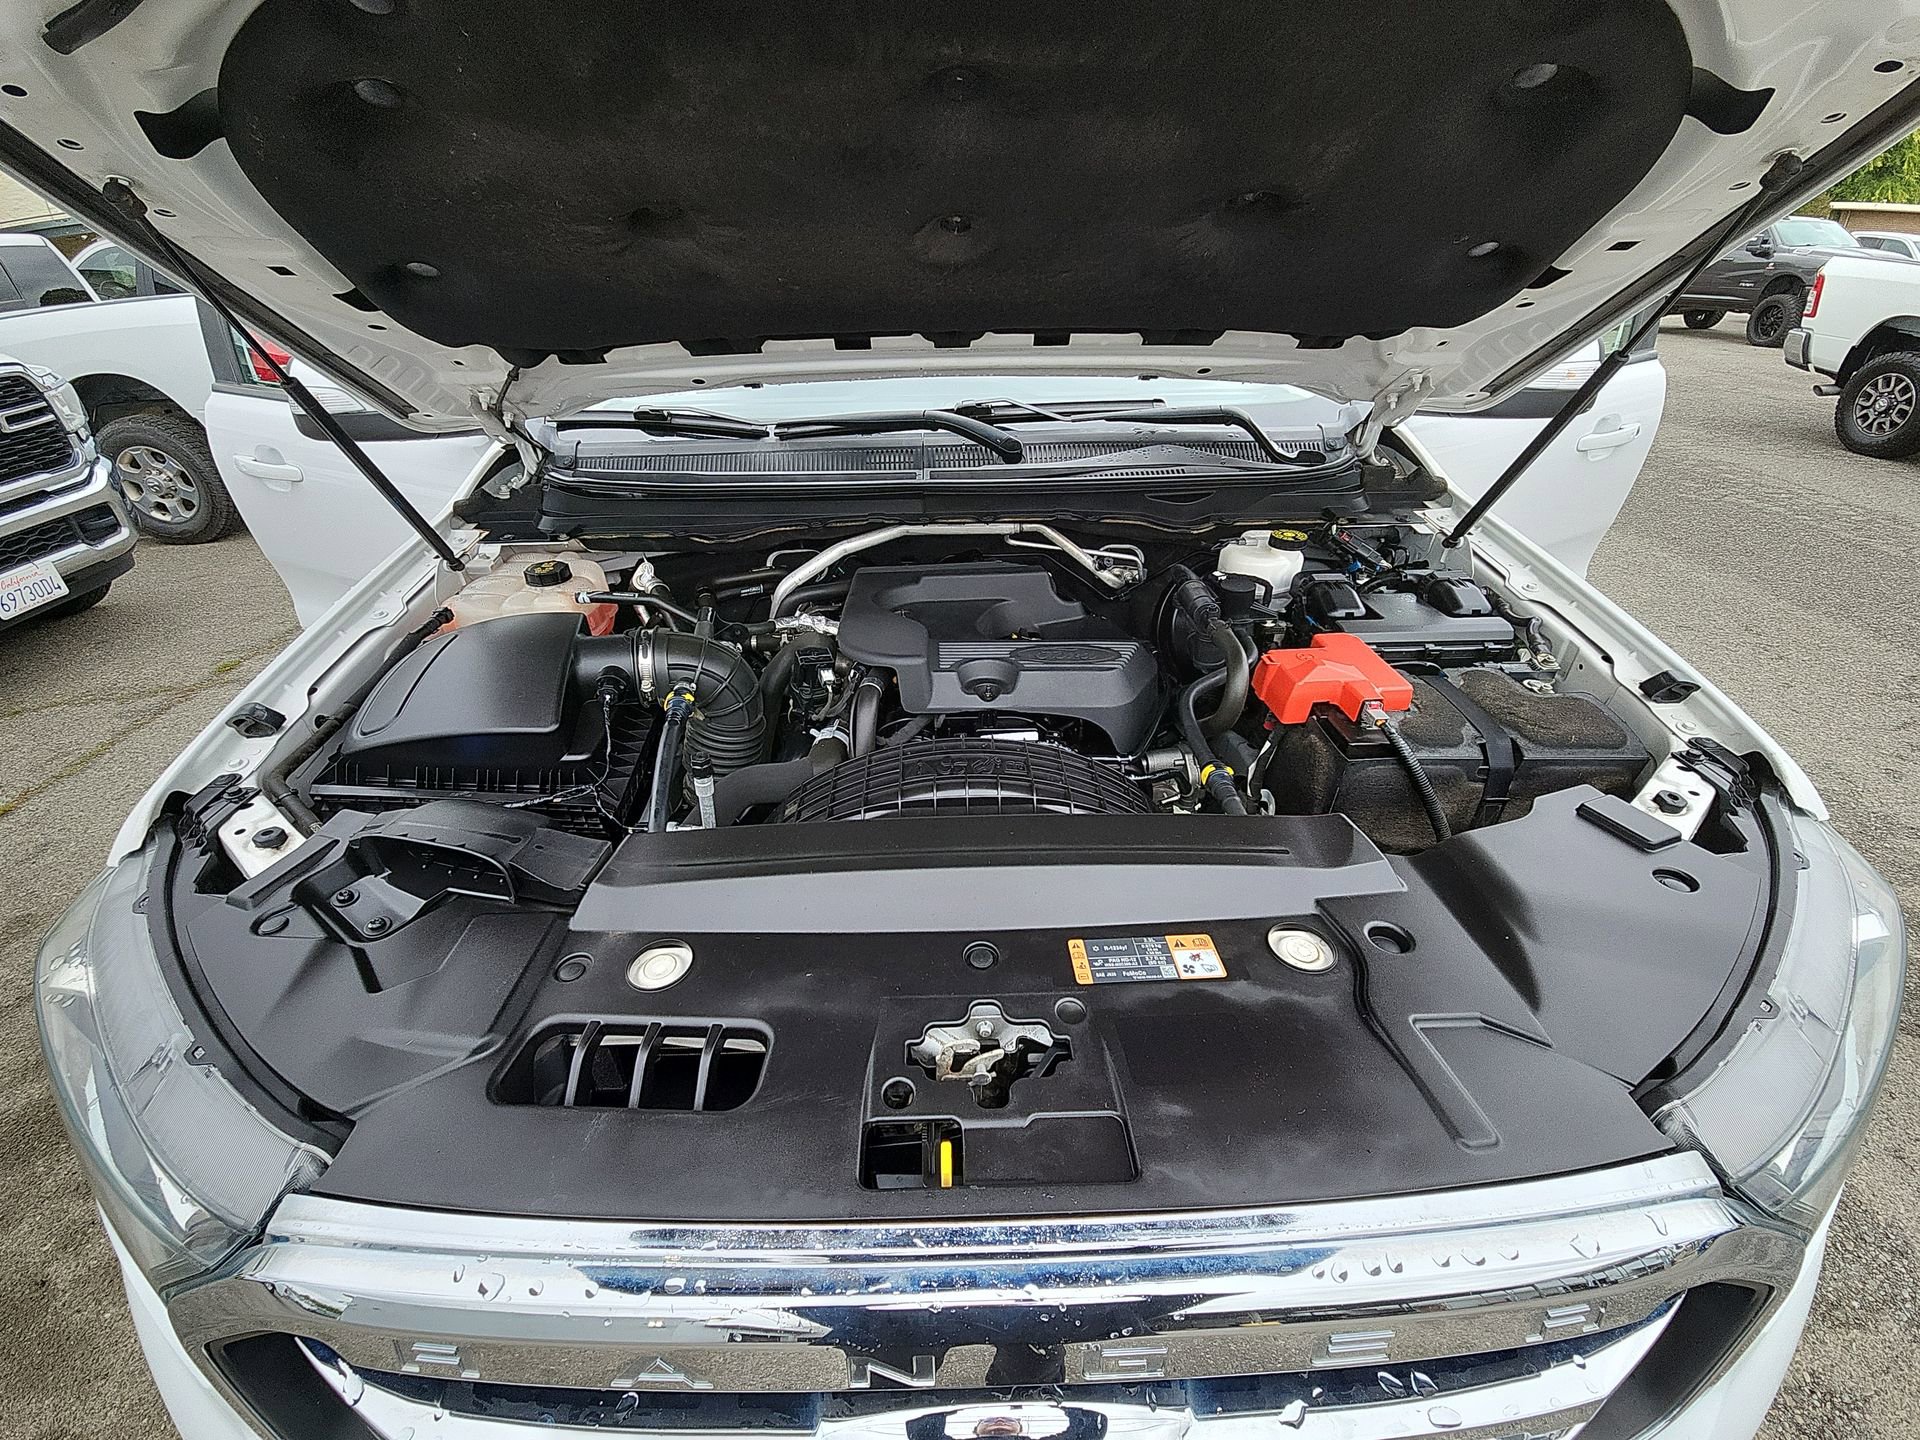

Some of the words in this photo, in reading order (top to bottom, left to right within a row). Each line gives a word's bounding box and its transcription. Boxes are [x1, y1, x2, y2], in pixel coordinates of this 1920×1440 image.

[0, 576, 62, 612] 69730D4
[1, 571, 43, 590] California
[1103, 944, 1128, 952] R-1234yf
[393, 1303, 1602, 1388] RANGER
